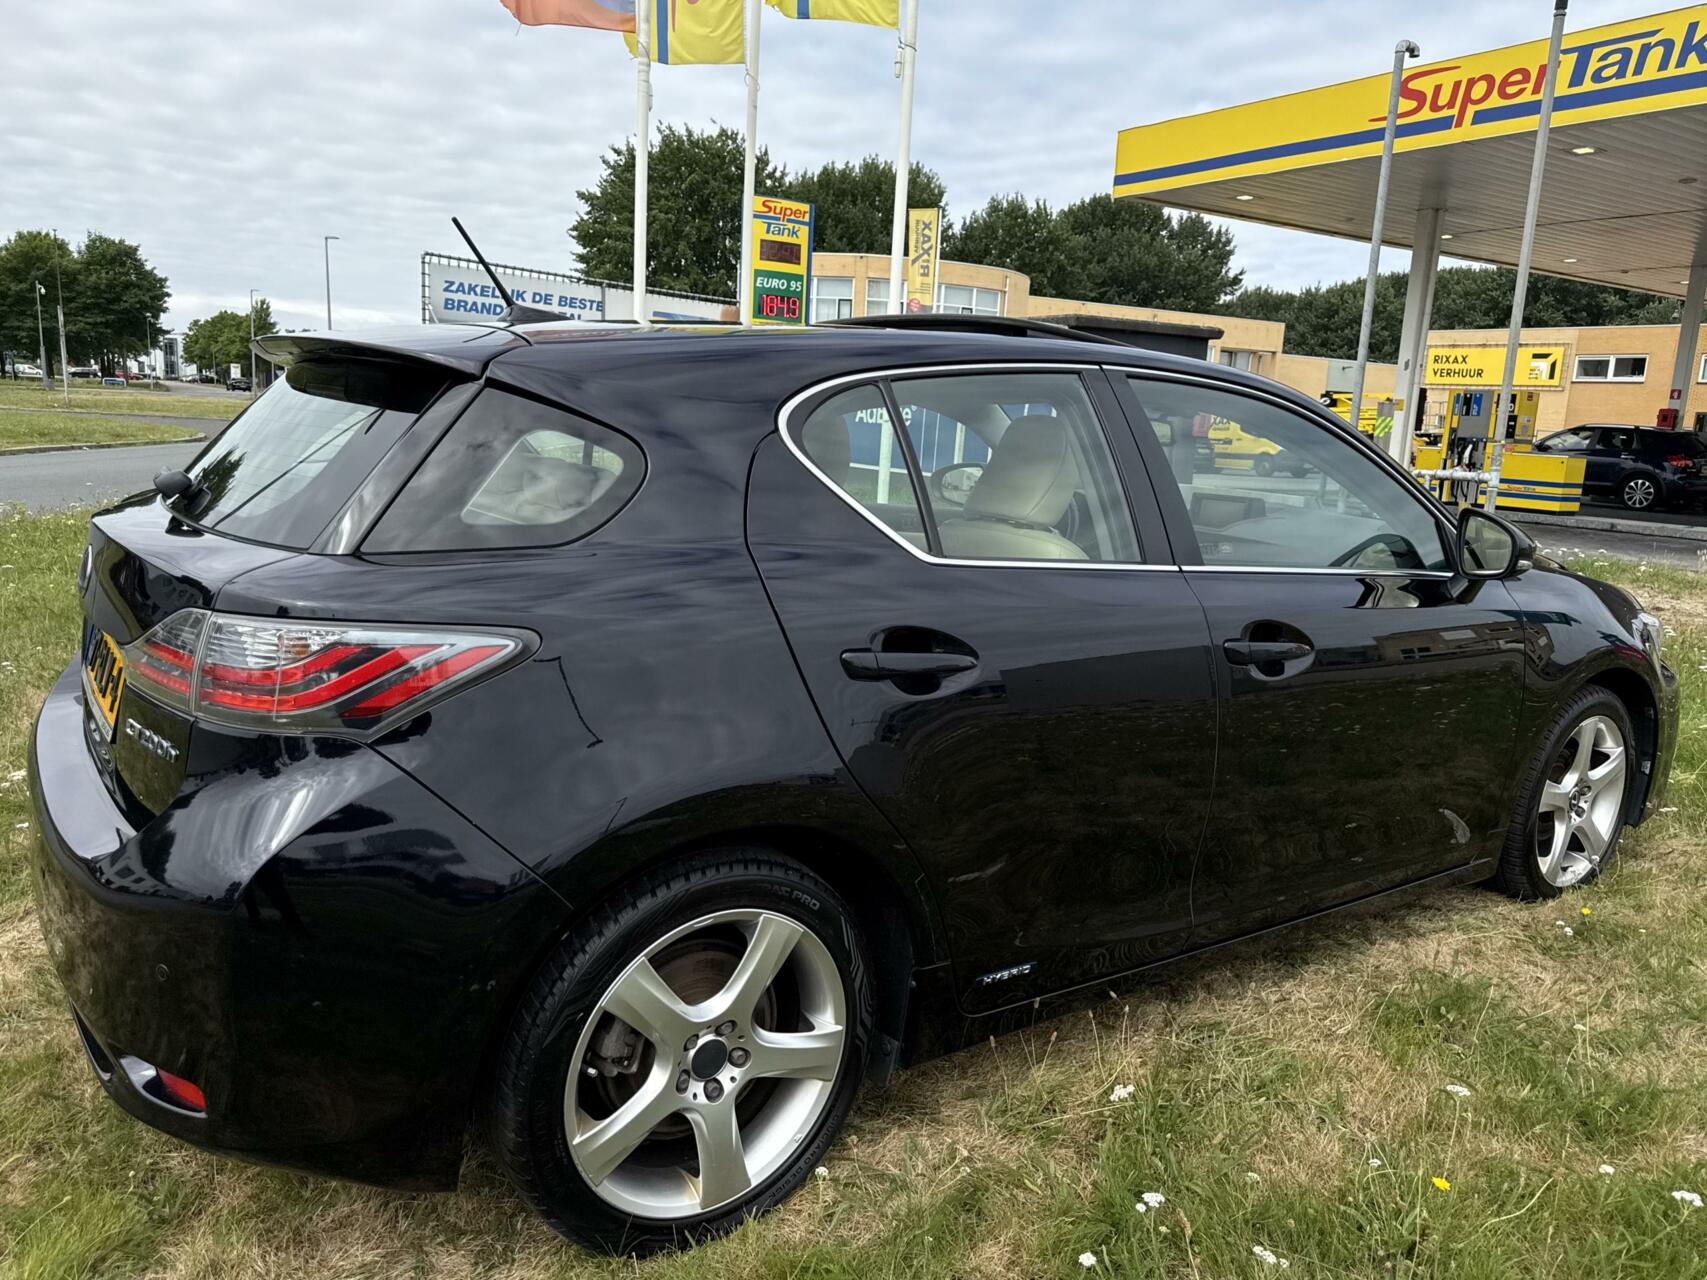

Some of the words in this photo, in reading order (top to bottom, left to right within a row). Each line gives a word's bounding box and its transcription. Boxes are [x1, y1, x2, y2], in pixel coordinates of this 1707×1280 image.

[1368, 66, 1561, 128] Super
[1560, 21, 1707, 89] Tank
[753, 199, 809, 222] Super
[762, 221, 801, 239] Tank
[756, 277, 787, 290] EURO
[789, 281, 802, 291] 95
[532, 291, 553, 305] DE
[558, 295, 603, 312] BESTE
[1433, 355, 1468, 365] RIXAX
[1433, 368, 1484, 378] VERHUUR
